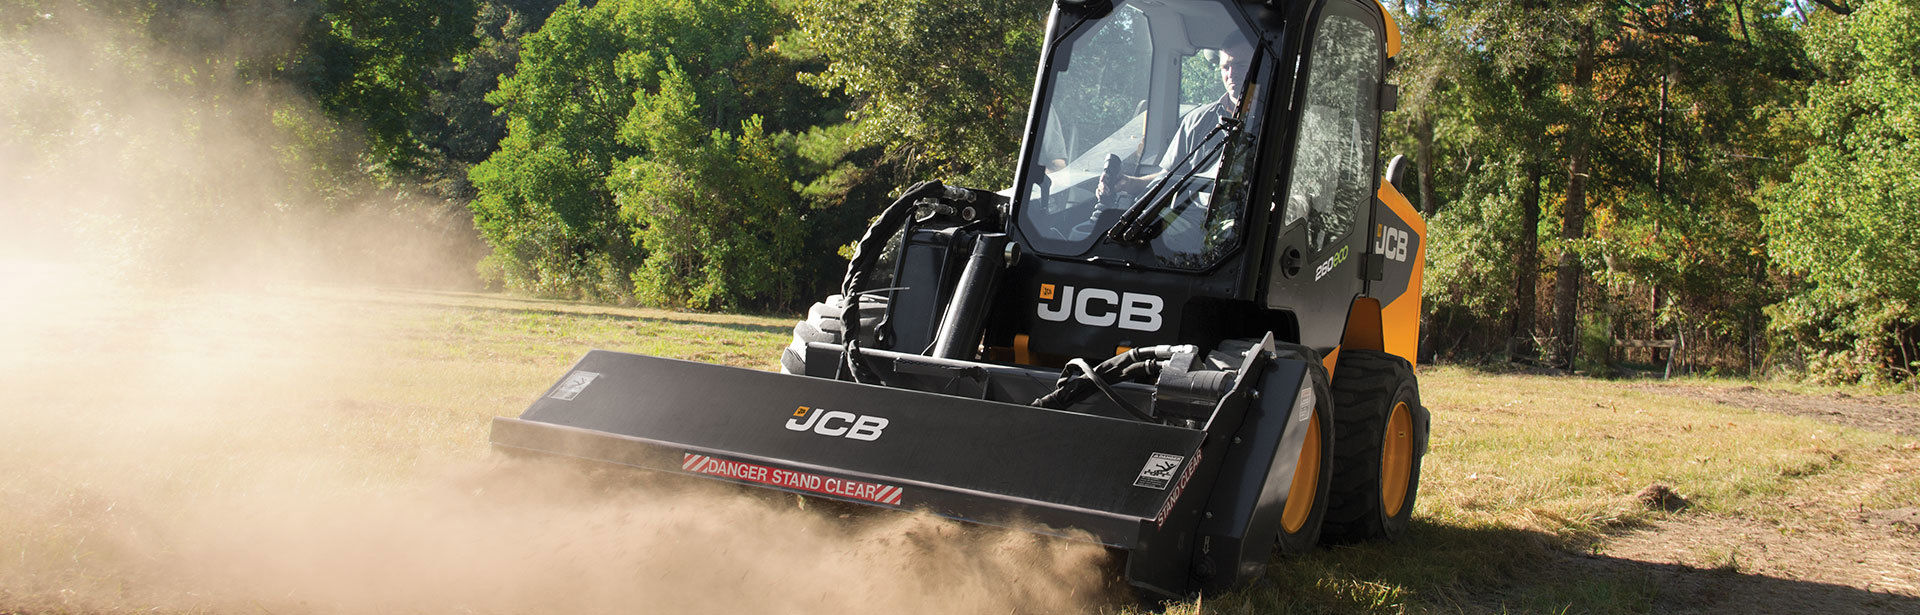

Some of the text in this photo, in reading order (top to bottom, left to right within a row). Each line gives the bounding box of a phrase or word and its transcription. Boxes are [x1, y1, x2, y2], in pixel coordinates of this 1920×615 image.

[1375, 225, 1408, 262] JCB
[1037, 285, 1164, 332] JCB
[785, 408, 889, 441] JCB
[708, 459, 876, 499] DANGER STAND CLEAR
[1158, 449, 1202, 526] STAND CLEAR
